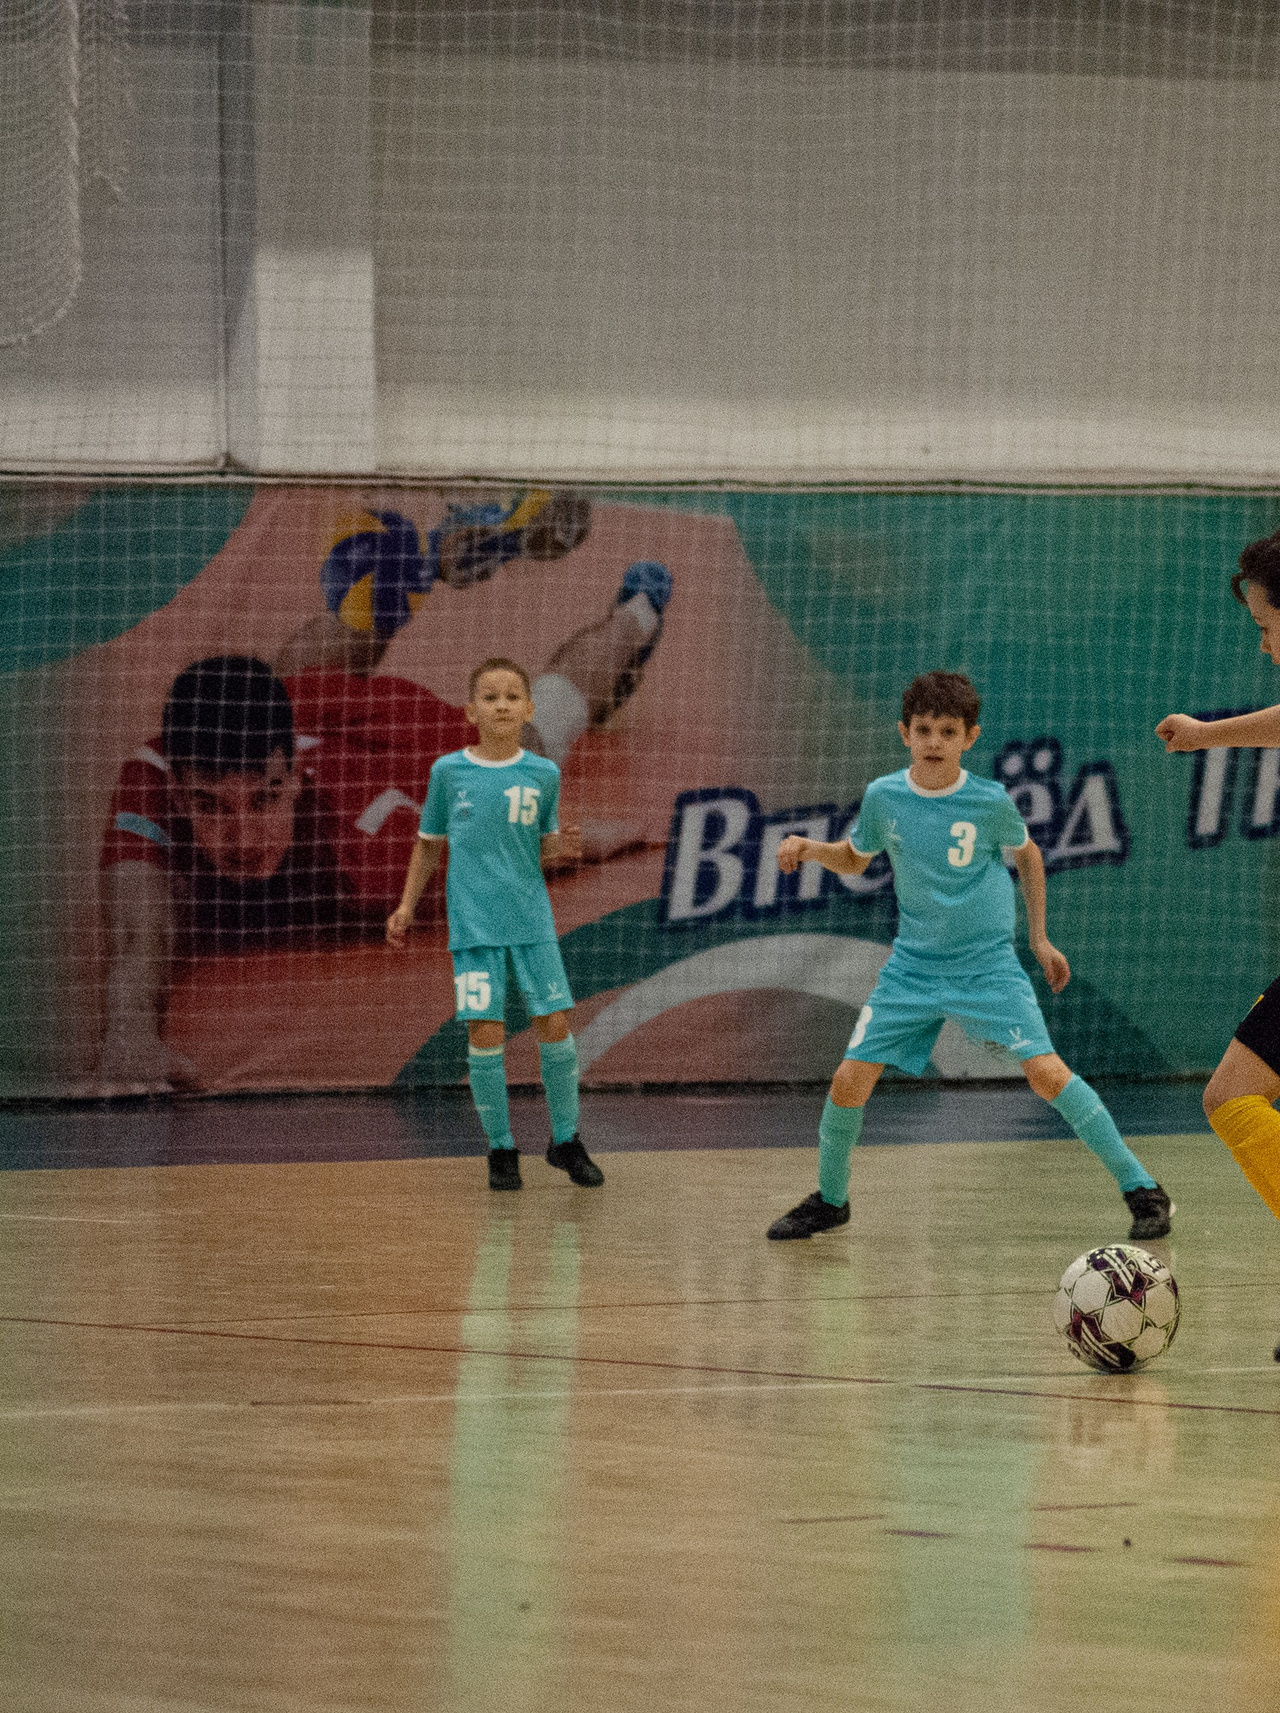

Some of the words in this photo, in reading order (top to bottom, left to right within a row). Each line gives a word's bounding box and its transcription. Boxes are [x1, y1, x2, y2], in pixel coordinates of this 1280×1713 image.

[504, 786, 540, 826] 15
[948, 821, 977, 868] 3
[455, 971, 492, 1012] 15
